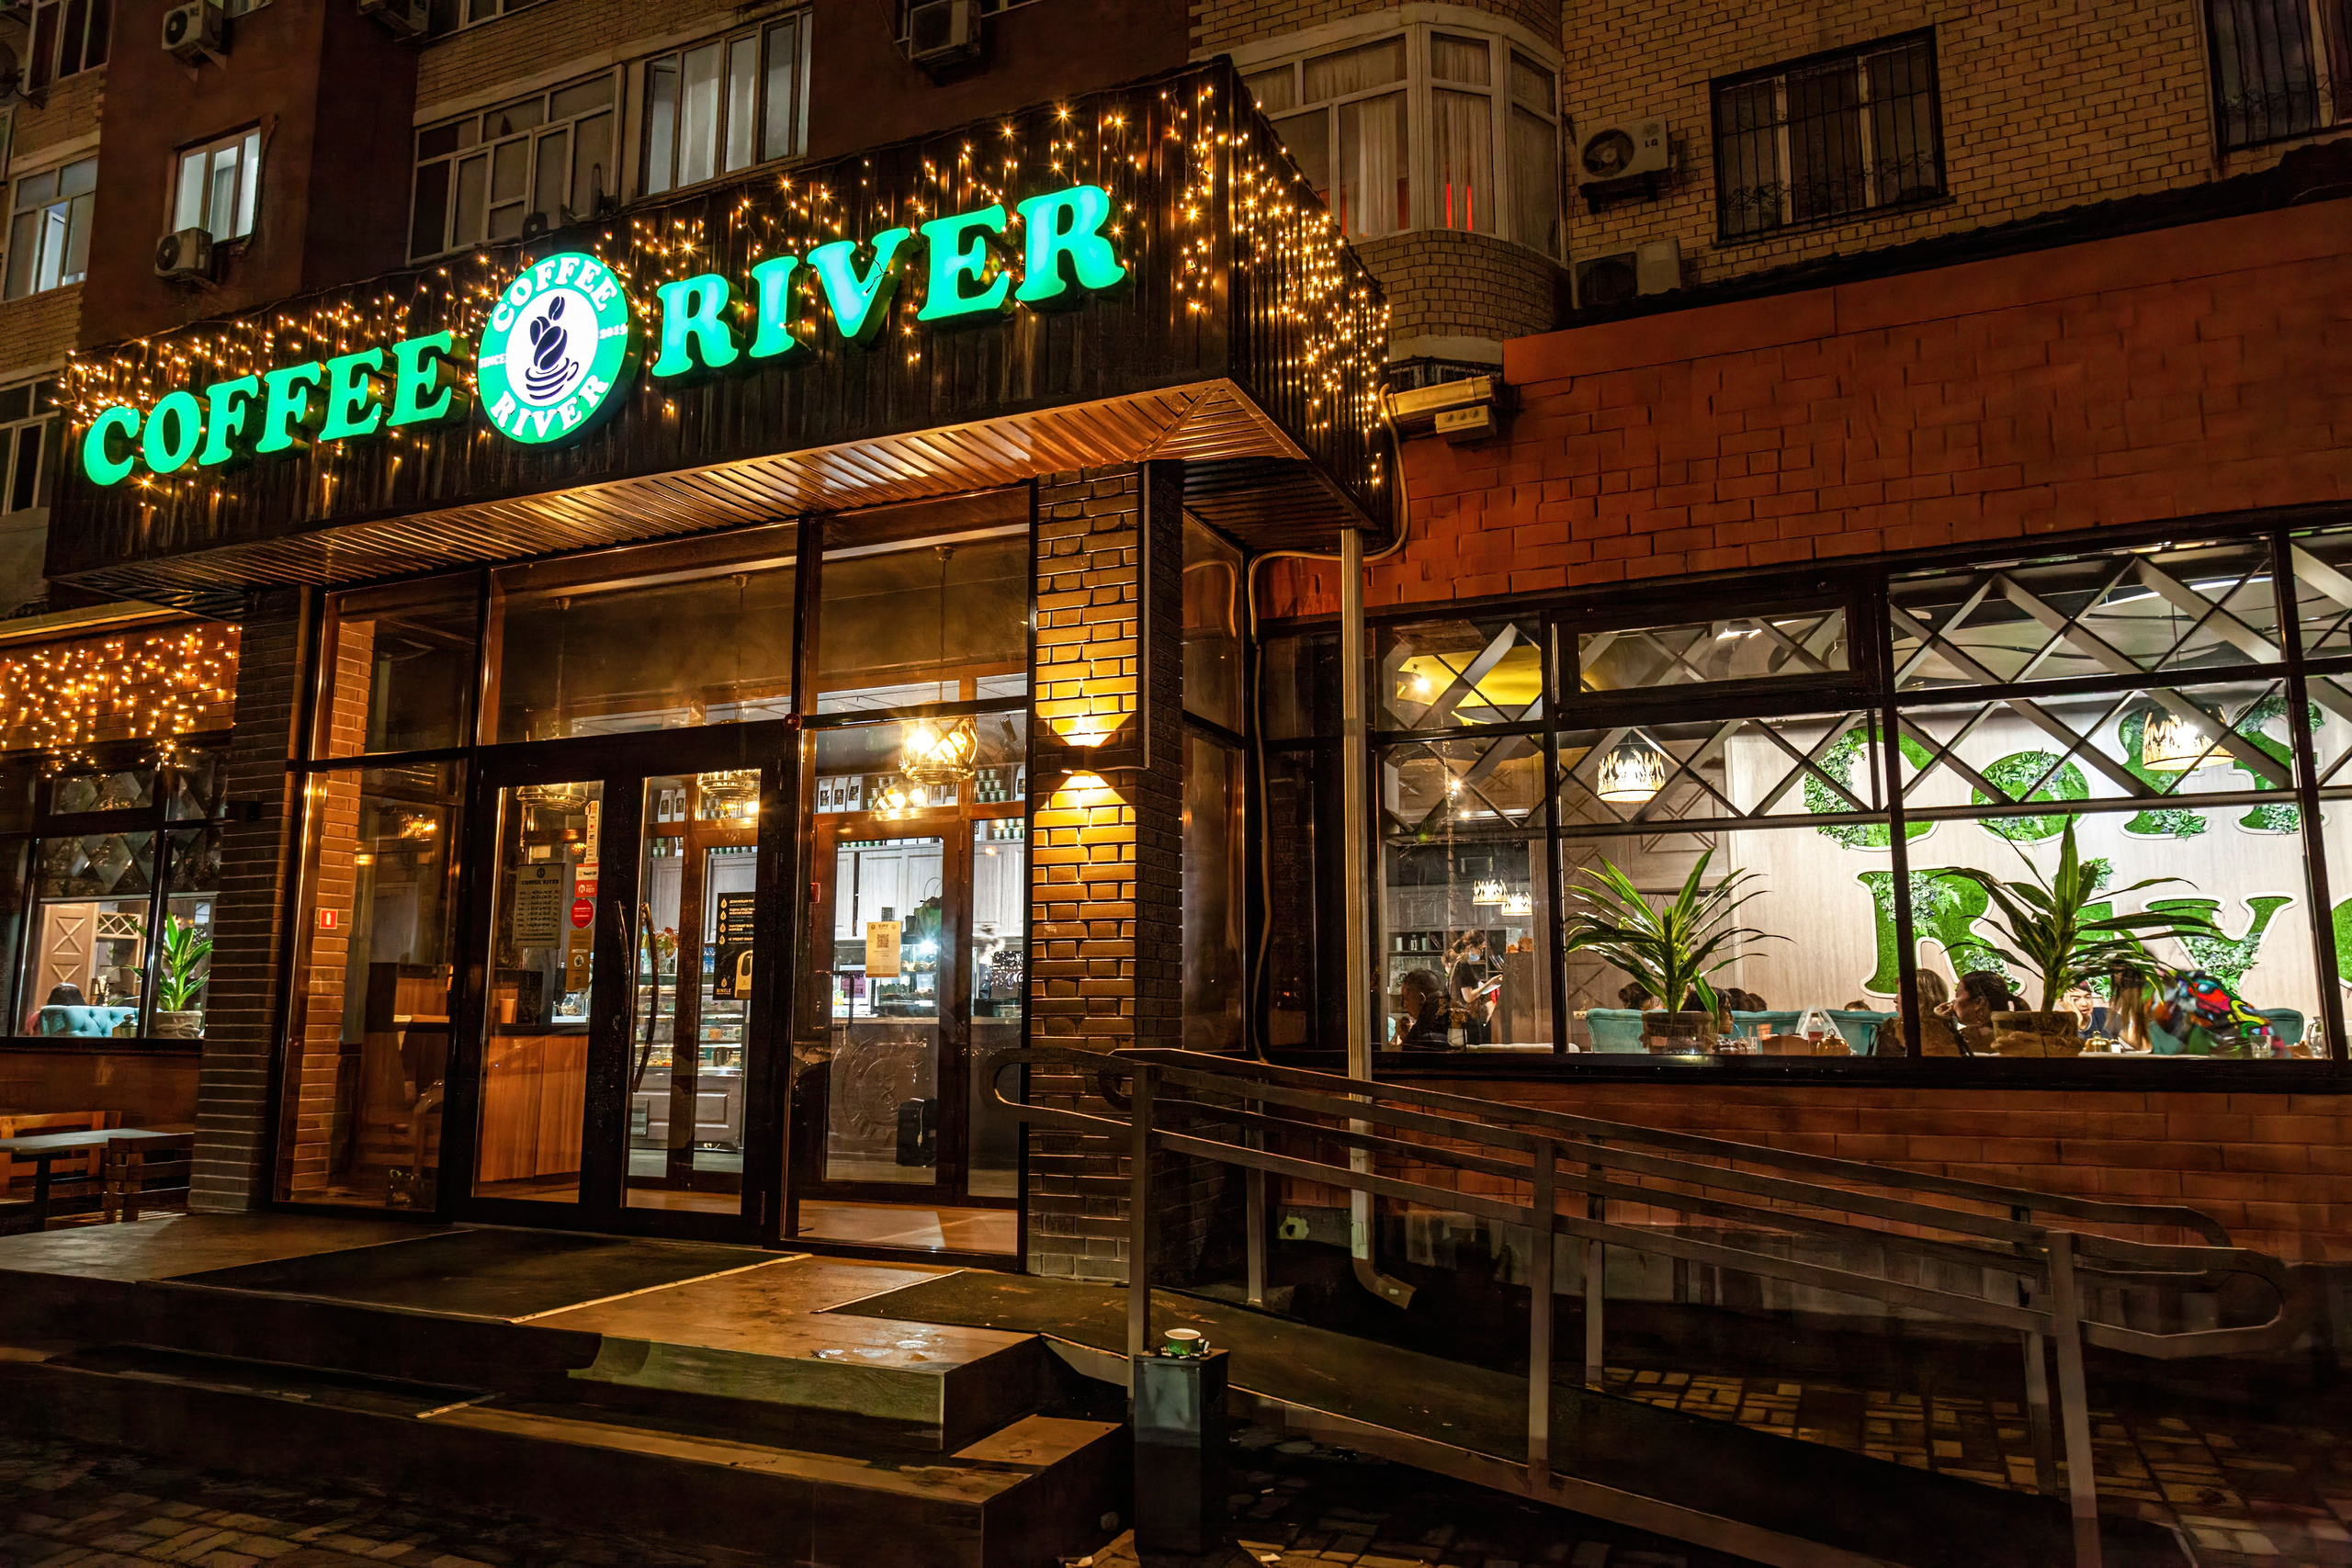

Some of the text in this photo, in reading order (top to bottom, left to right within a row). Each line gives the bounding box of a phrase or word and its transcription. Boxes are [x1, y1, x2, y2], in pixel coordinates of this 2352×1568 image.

[1645, 139, 1657, 148] LG
[492, 257, 617, 333] COFFEE
[84, 185, 1125, 486] COFFEE RIVER
[490, 374, 609, 438] RIVER
